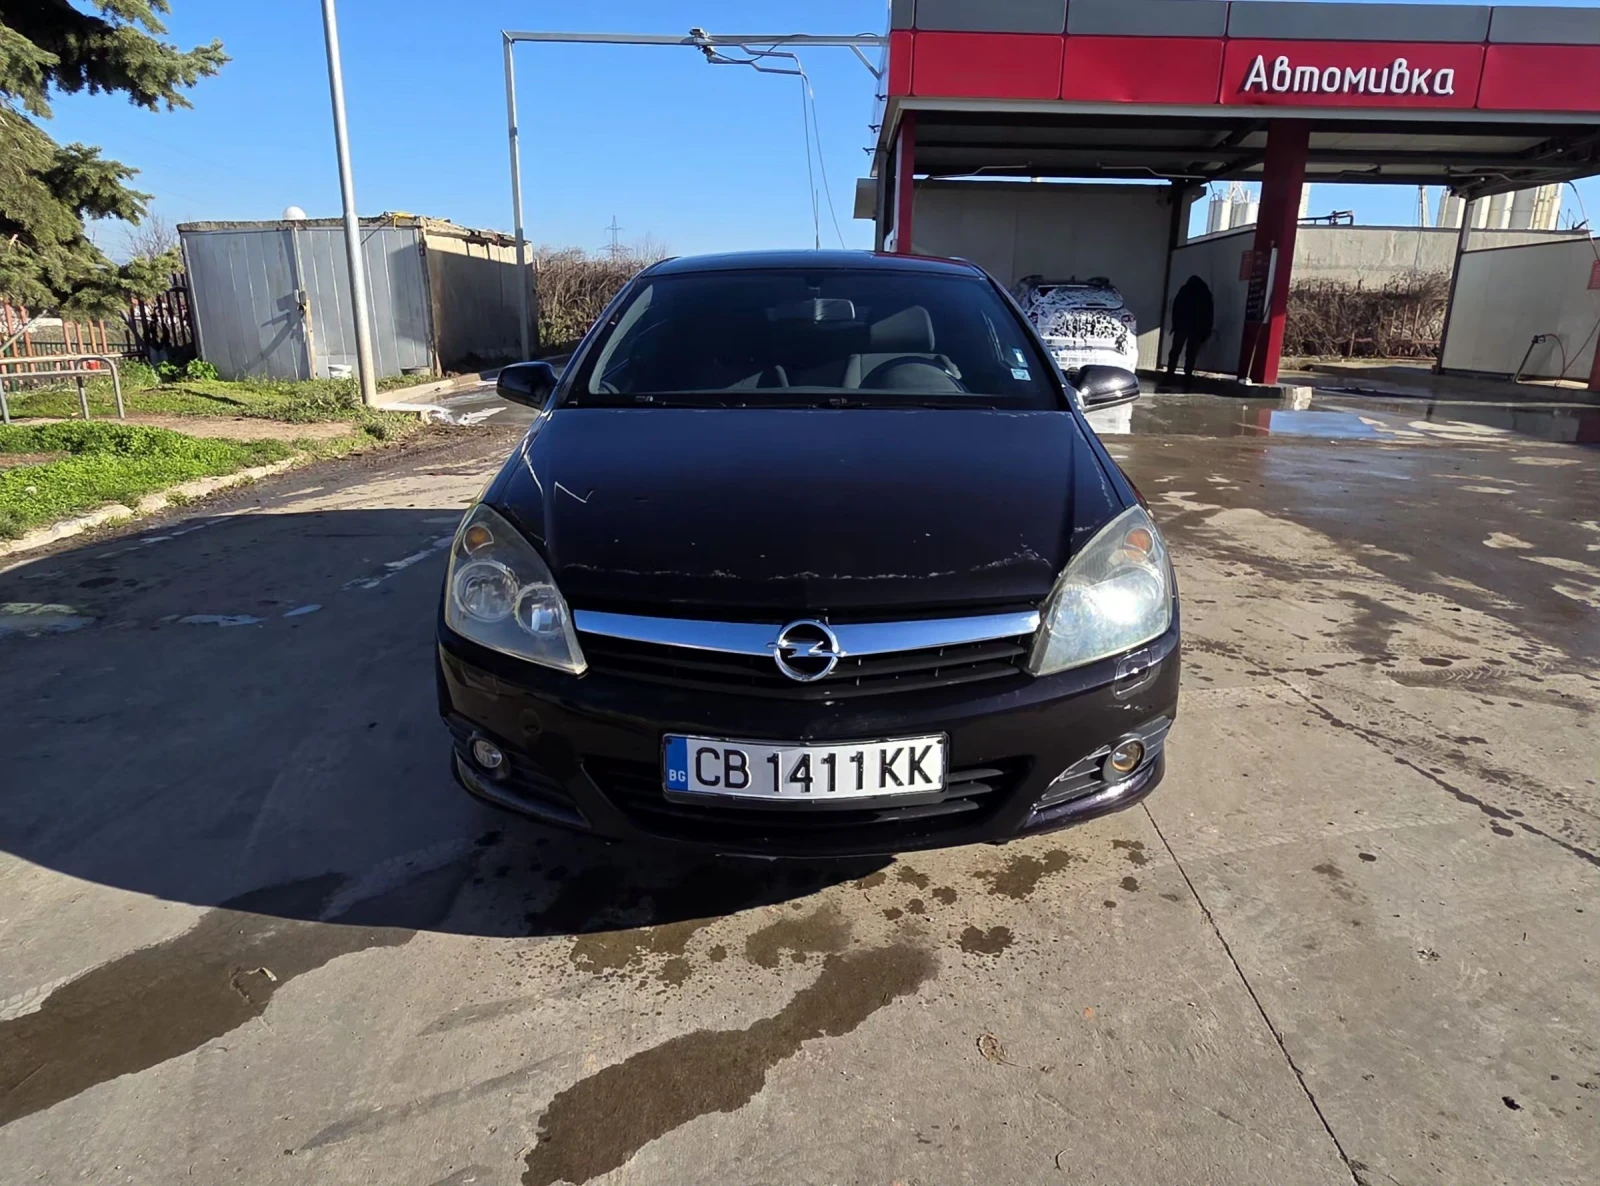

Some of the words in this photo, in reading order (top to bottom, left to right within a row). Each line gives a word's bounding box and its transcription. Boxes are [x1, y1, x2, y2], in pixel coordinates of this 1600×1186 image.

[1244, 54, 1455, 95] Автомивка
[668, 769, 687, 783] BG
[695, 747, 750, 789] CB
[766, 751, 864, 793] 1411
[879, 745, 934, 788] KK
